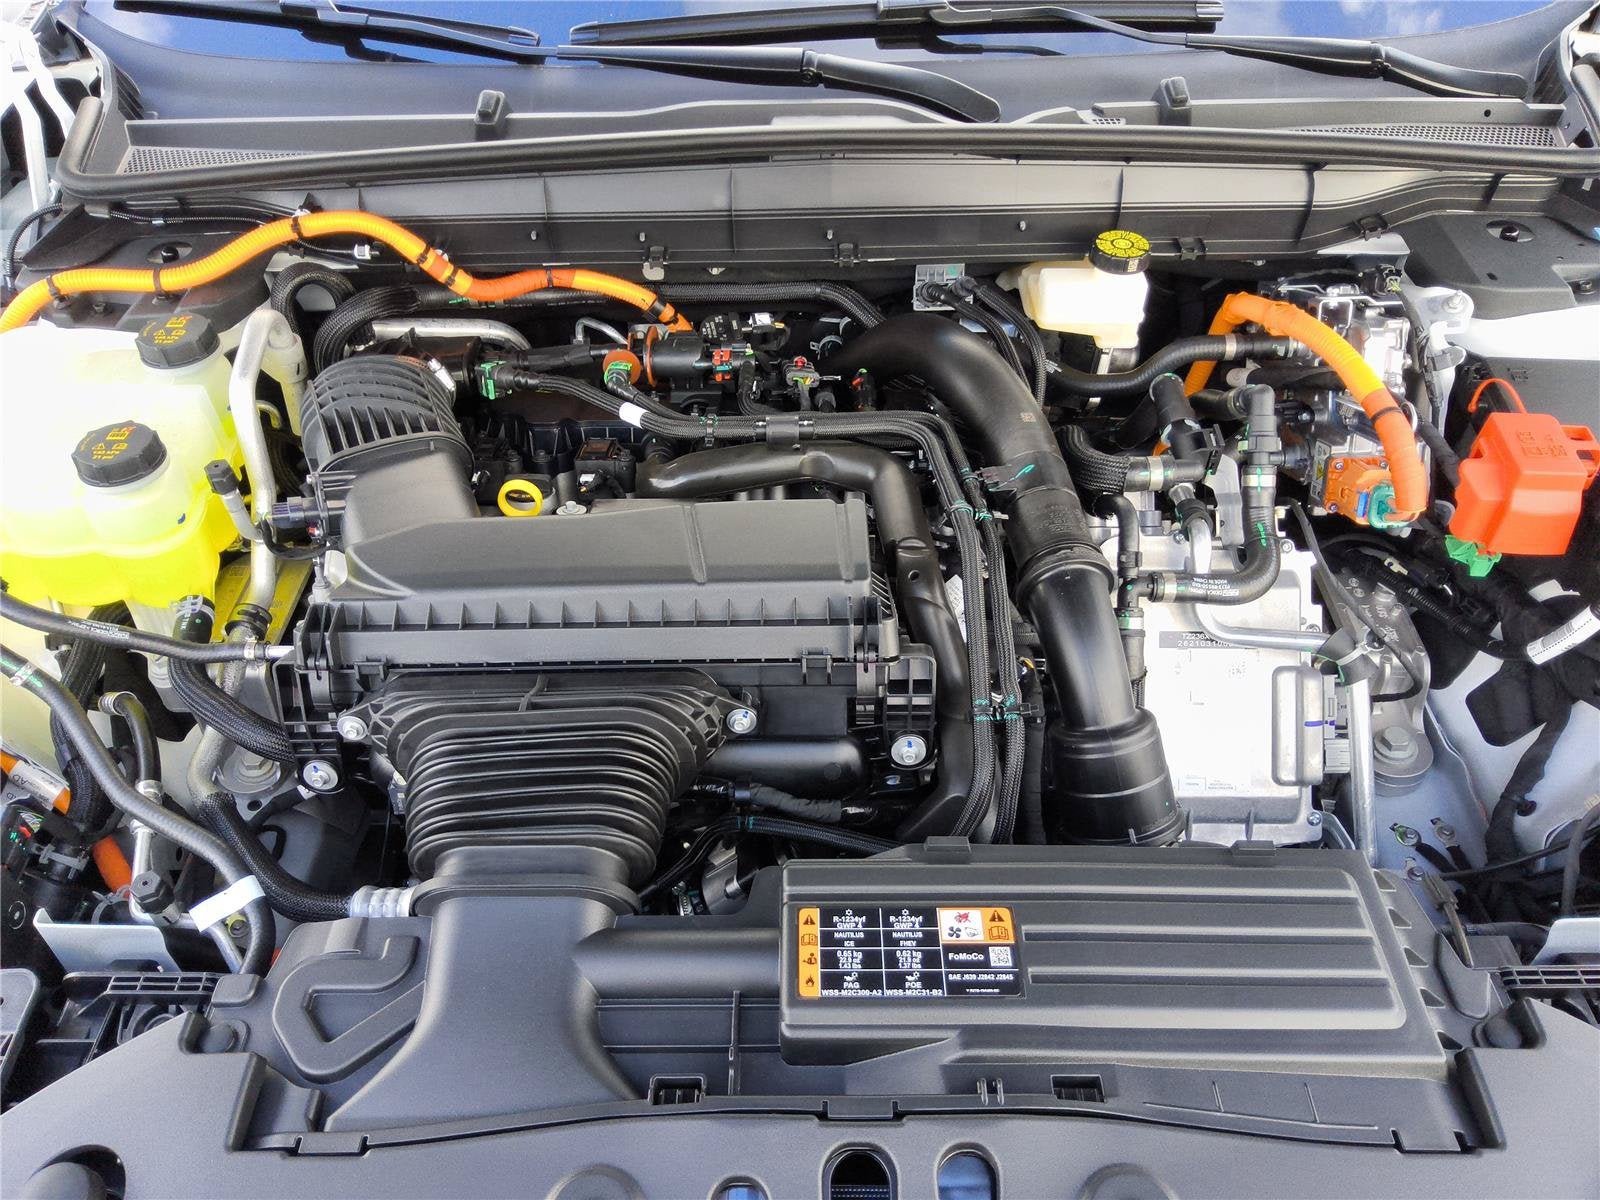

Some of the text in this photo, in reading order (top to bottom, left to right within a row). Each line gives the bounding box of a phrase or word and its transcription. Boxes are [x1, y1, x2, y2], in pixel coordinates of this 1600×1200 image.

[832, 915, 866, 924] R-1234yf
[889, 915, 923, 924] R-1234yf
[853, 950, 863, 959] kg
[912, 950, 922, 959] kg
[948, 952, 984, 960] FoMoCo
